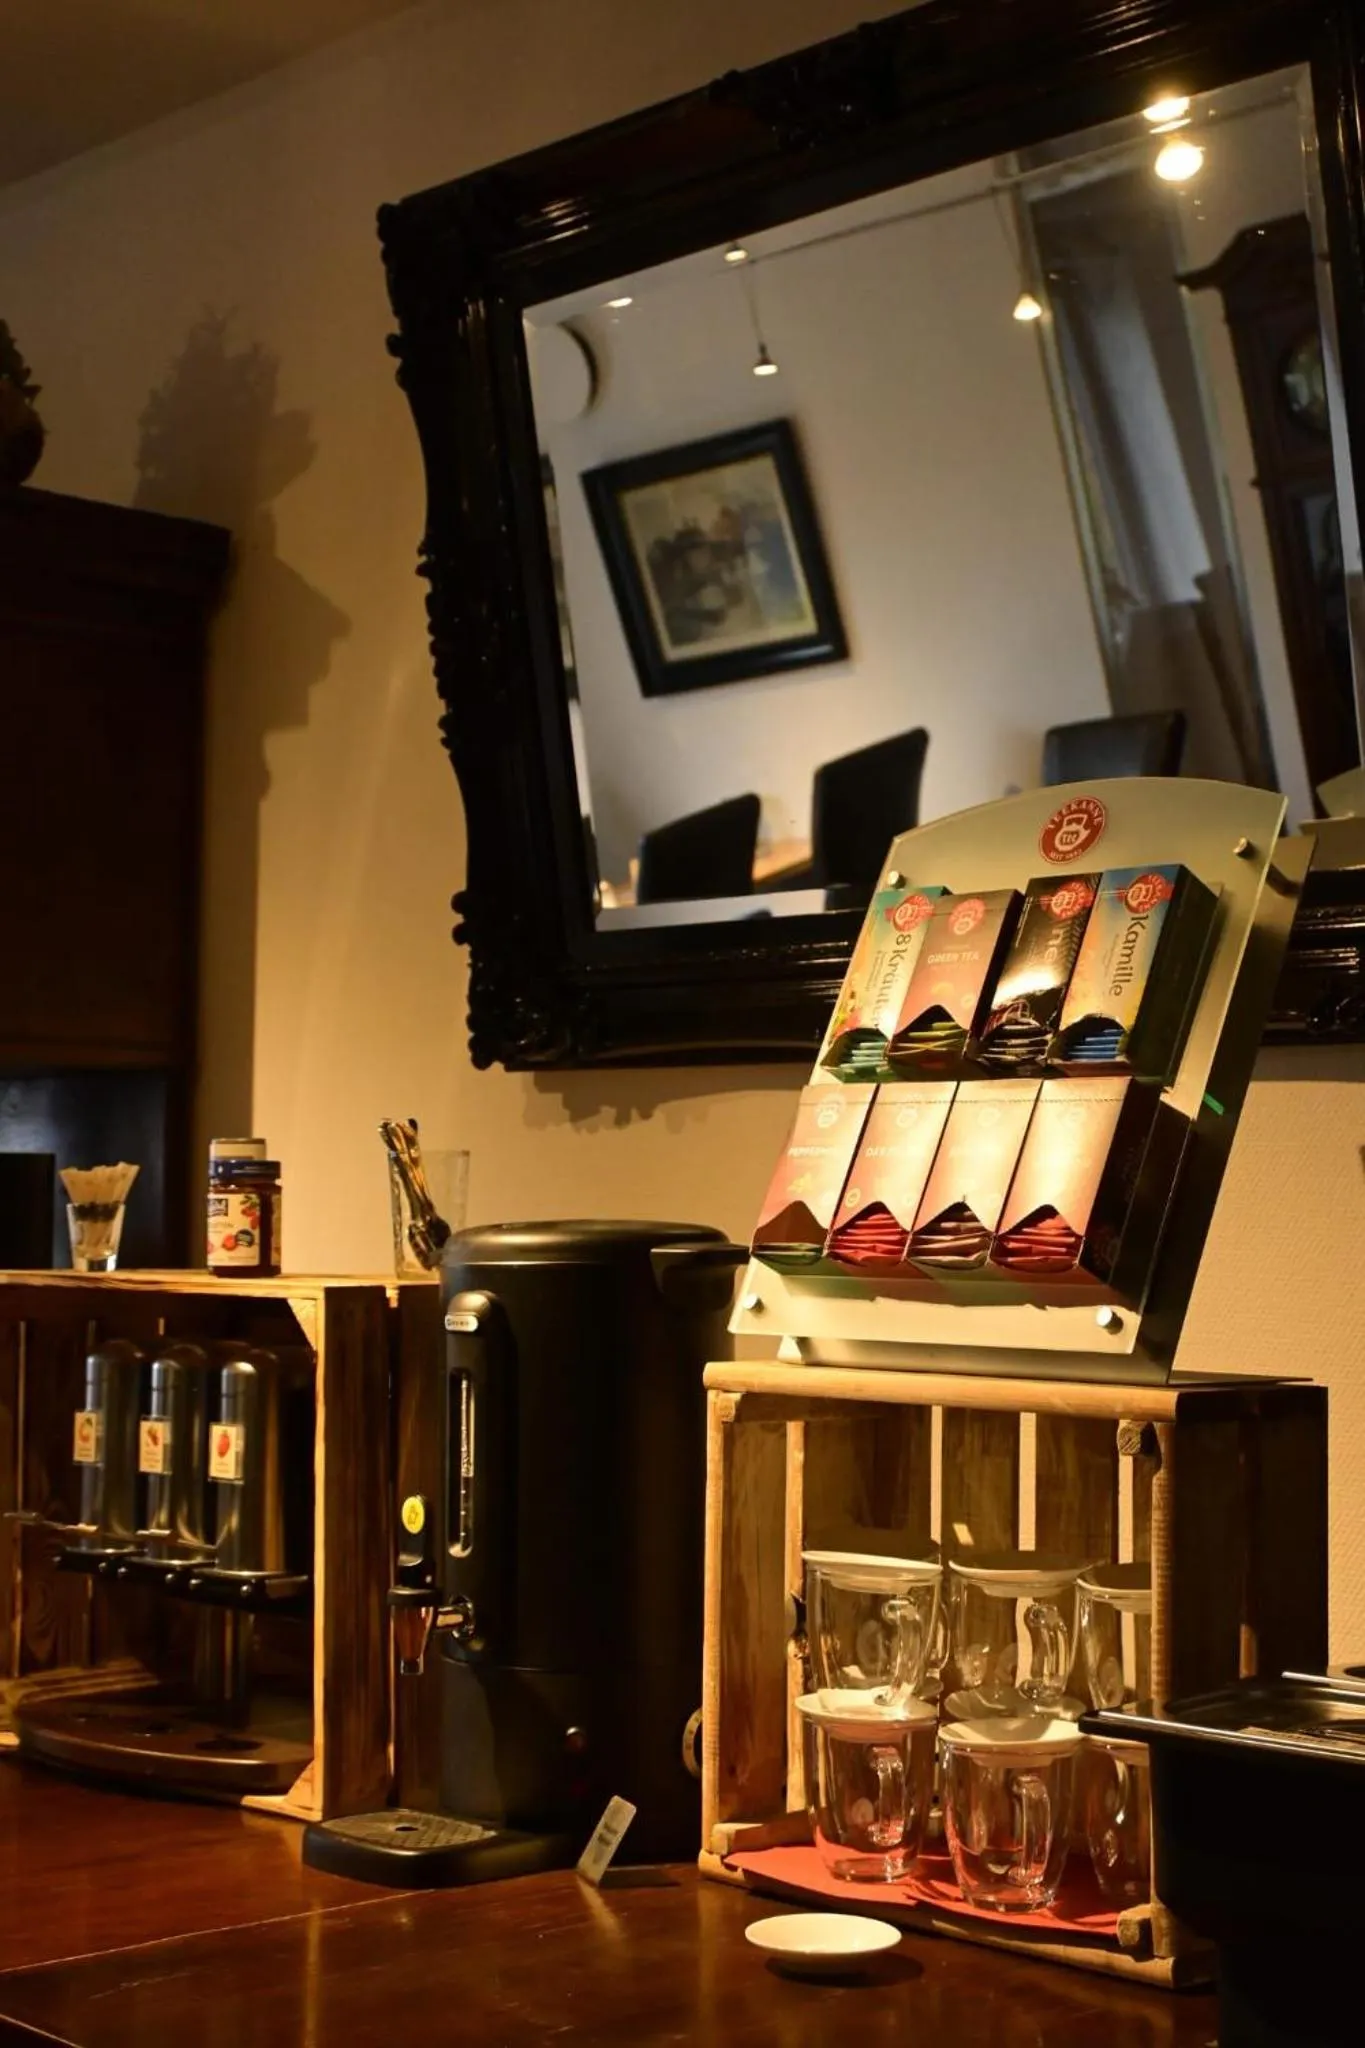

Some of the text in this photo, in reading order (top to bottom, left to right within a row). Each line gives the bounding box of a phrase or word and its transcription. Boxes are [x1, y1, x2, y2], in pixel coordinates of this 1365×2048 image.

[896, 933, 912, 946] 8
[960, 950, 980, 962] TEA
[1109, 914, 1149, 997] Kamille
